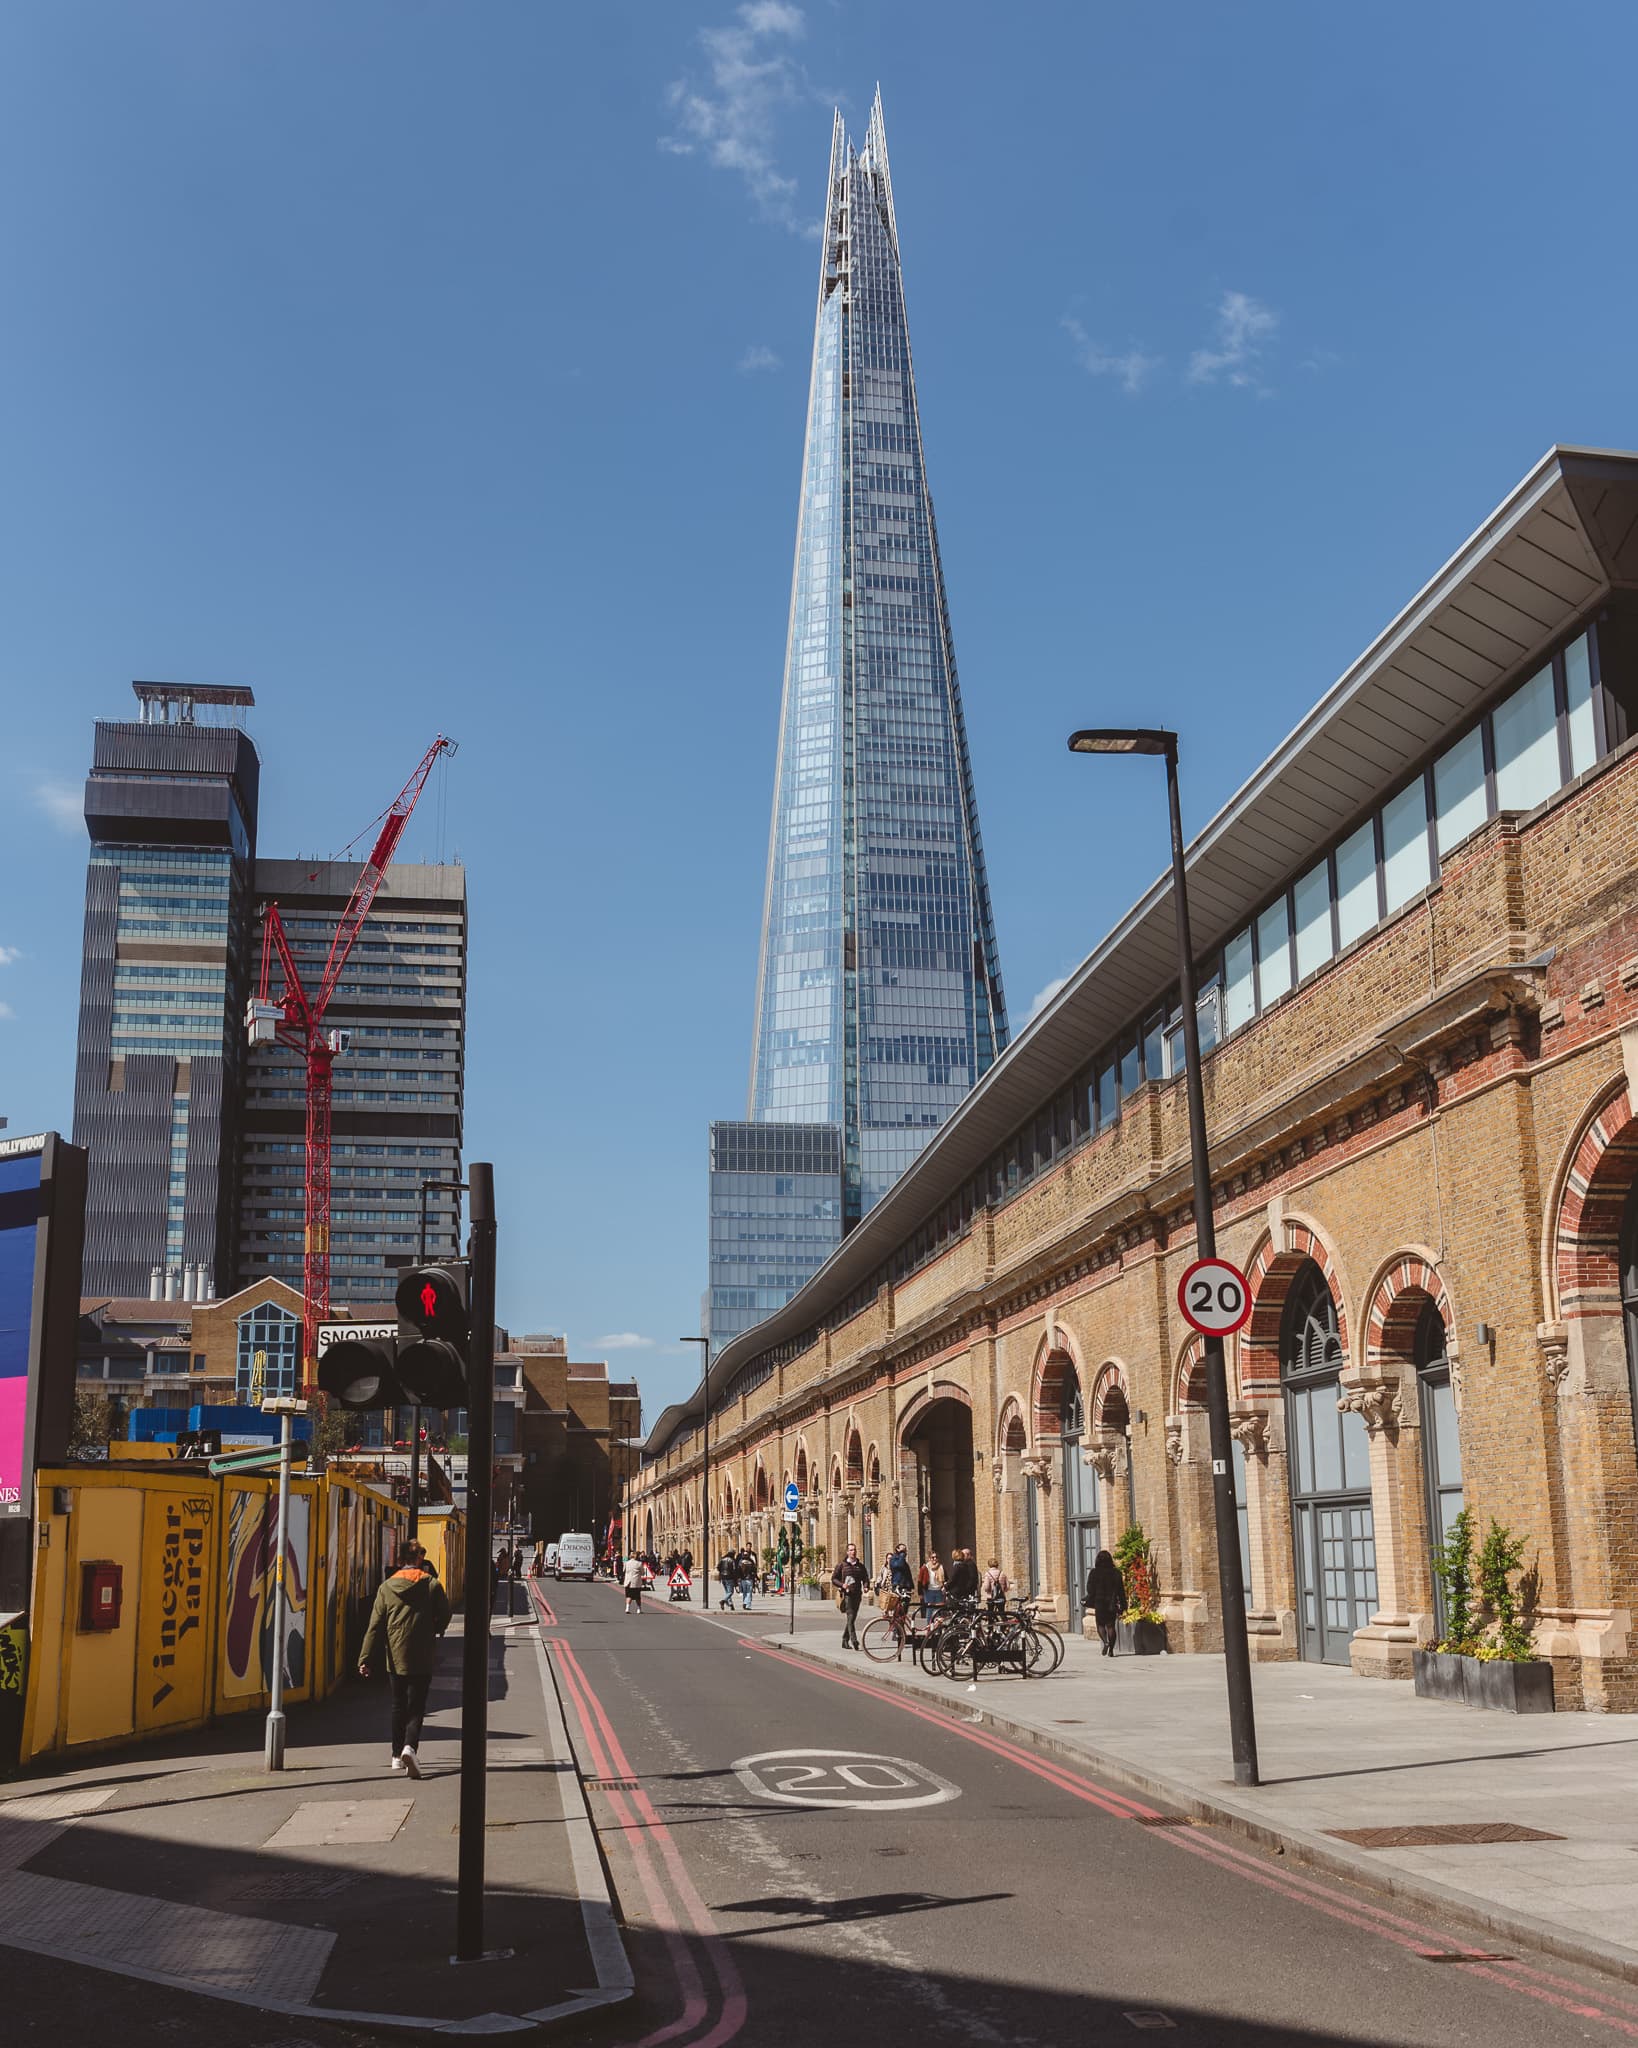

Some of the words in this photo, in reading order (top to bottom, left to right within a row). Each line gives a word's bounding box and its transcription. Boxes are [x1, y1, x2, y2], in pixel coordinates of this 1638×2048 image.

[0, 1134, 46, 1154] OLLYWOOD
[1190, 1281, 1242, 1313] 20
[178, 1528, 204, 1640] Yard
[153, 1505, 184, 1709] Vinegar
[761, 1764, 920, 1791] 20
